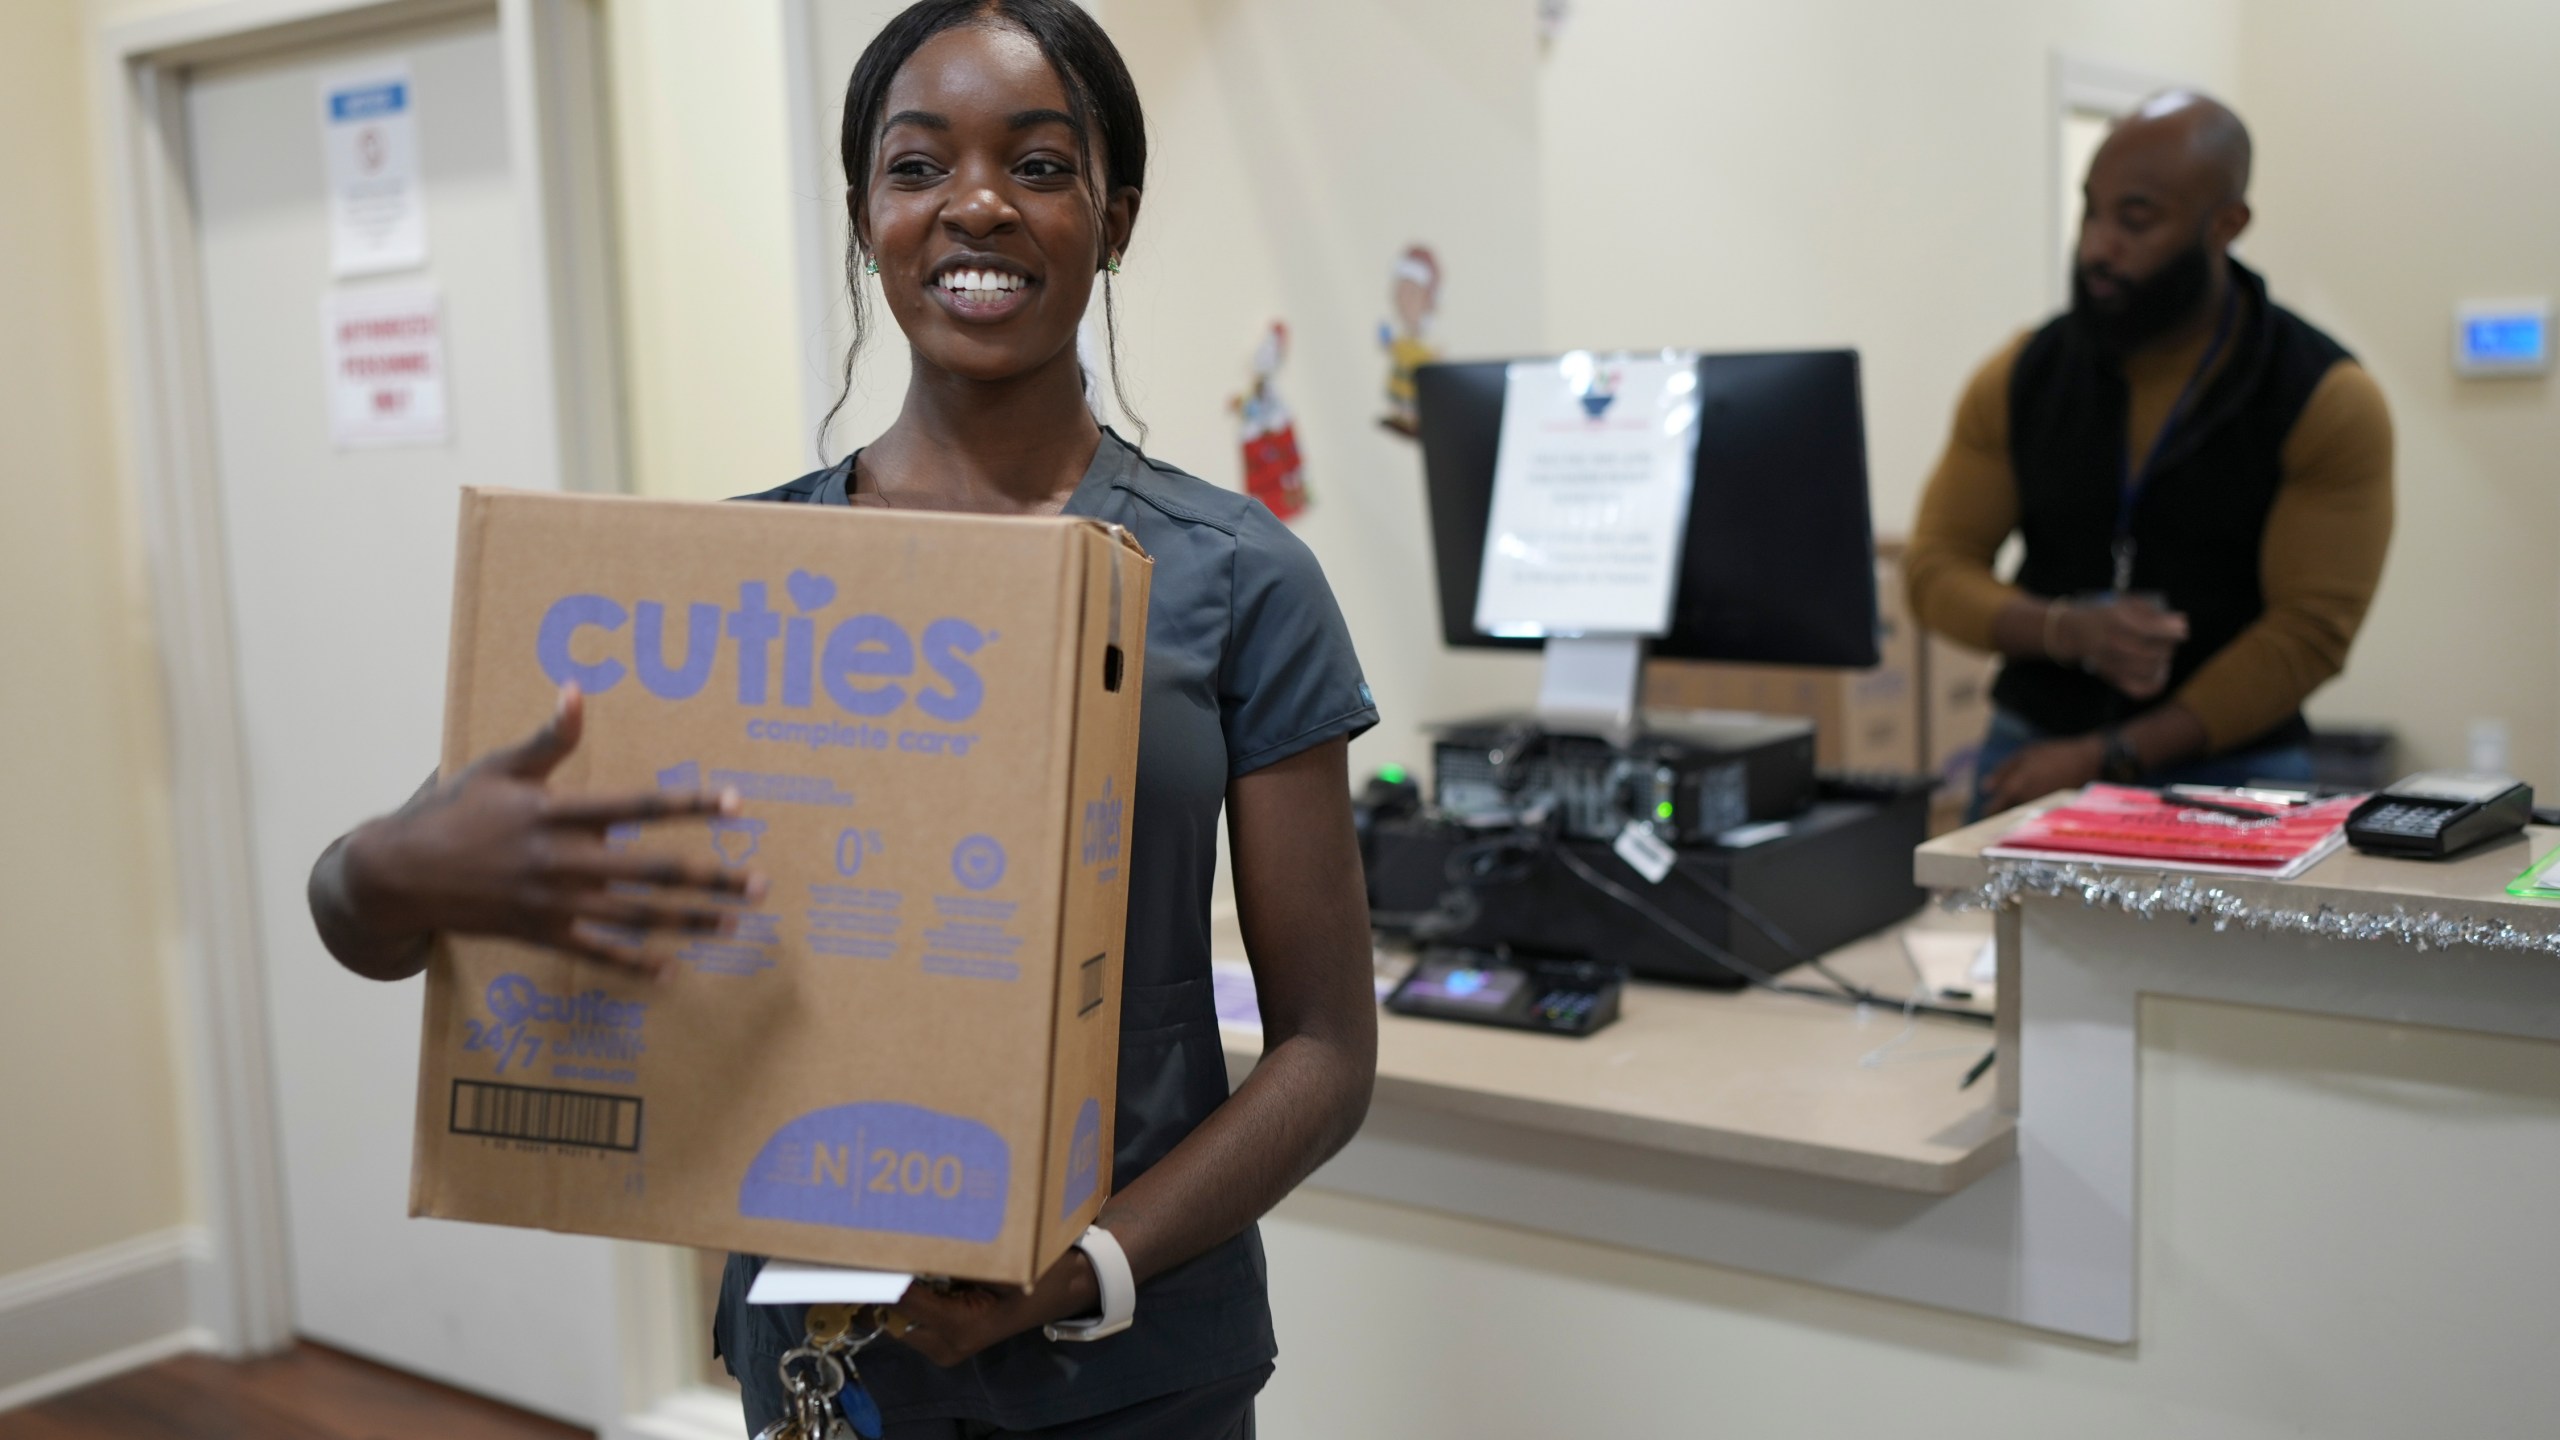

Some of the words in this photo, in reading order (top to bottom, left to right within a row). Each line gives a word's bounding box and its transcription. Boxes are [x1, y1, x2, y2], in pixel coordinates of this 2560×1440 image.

[537, 569, 989, 722] cuties
[745, 716, 891, 751] complete
[532, 988, 646, 1029] cuties
[463, 1018, 542, 1075] 24/7
[811, 1140, 850, 1188] N
[867, 1147, 964, 1200] 200
